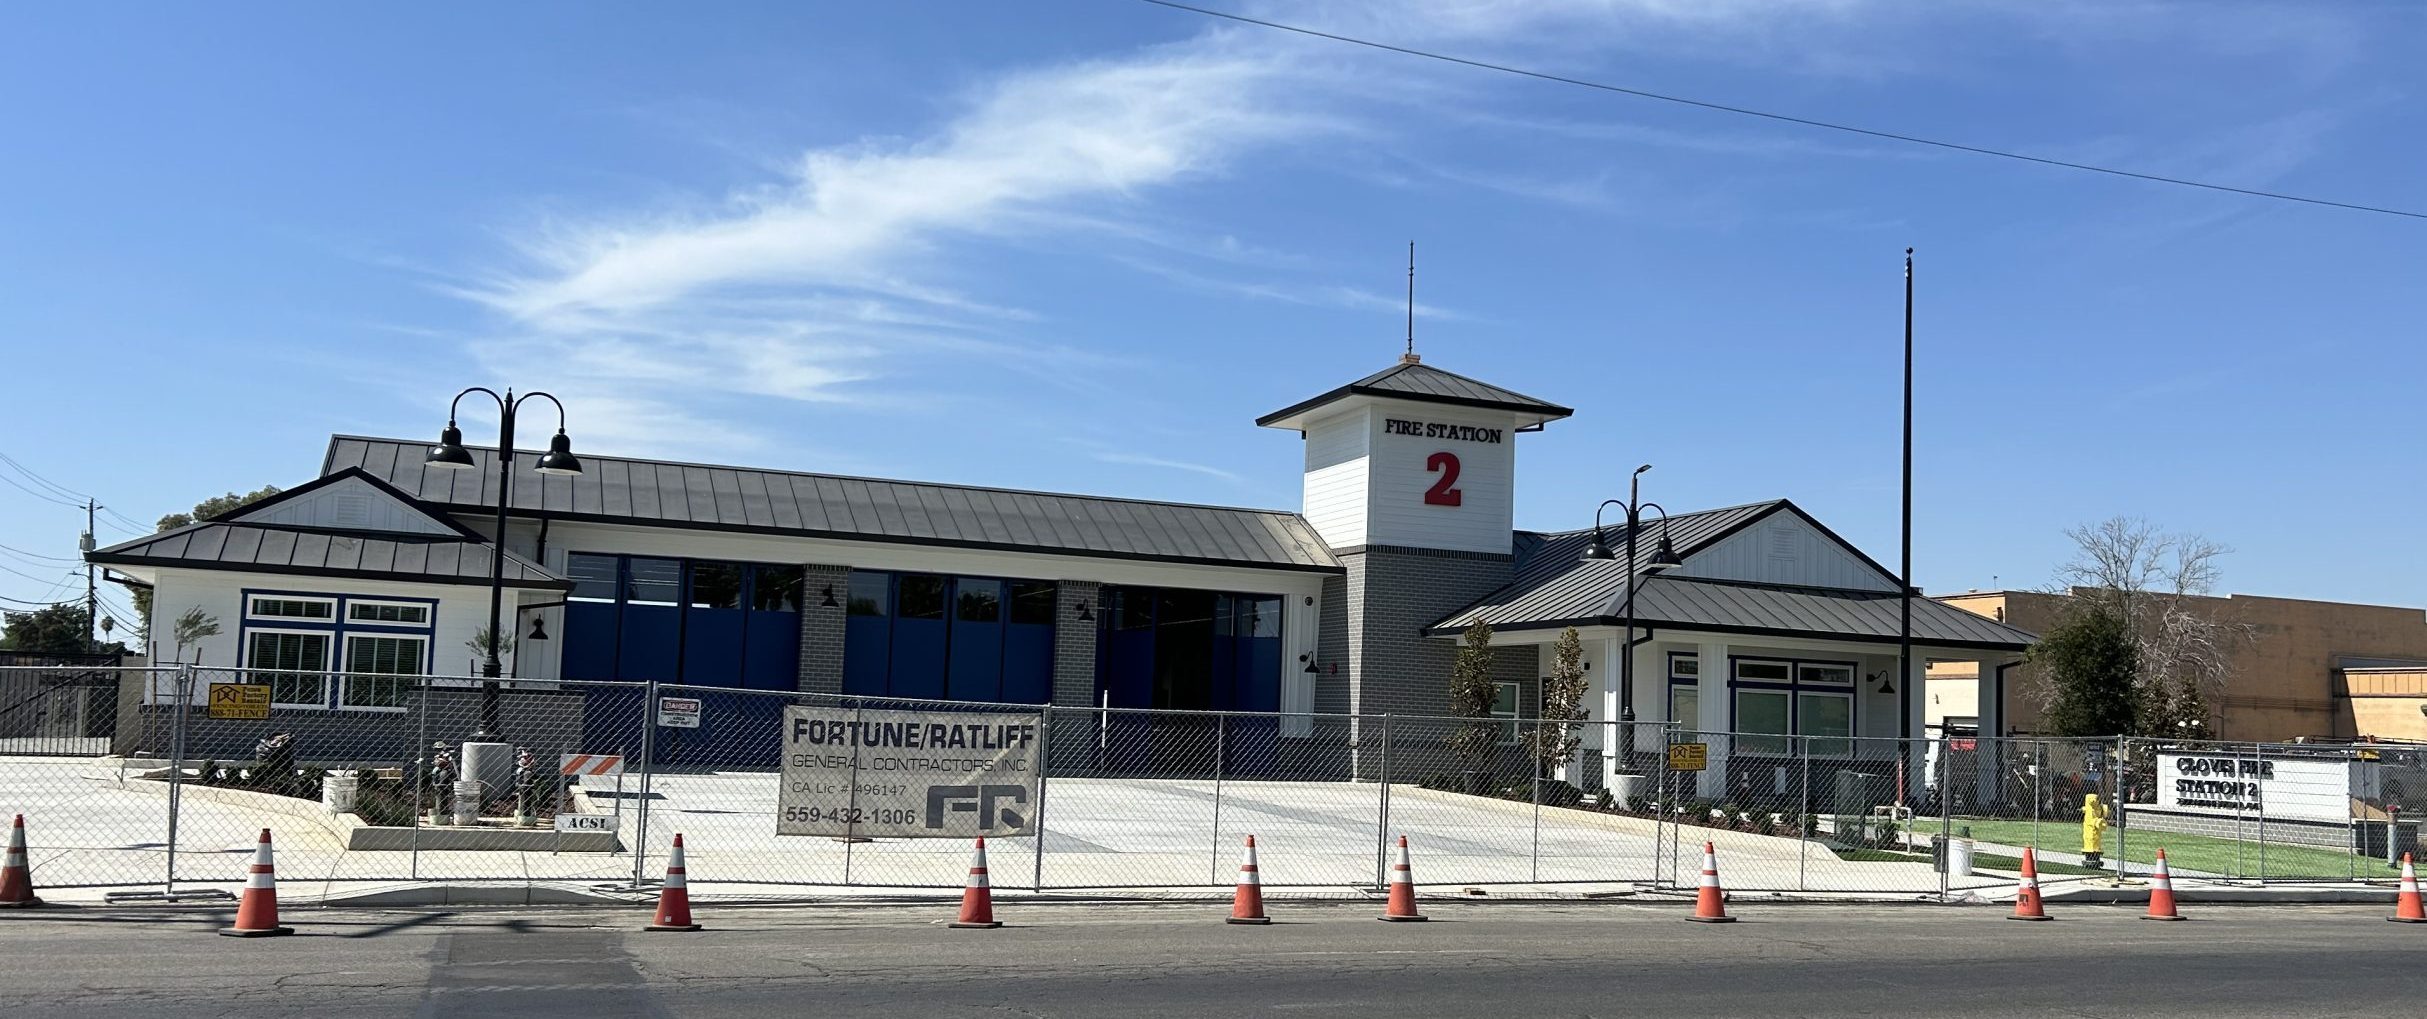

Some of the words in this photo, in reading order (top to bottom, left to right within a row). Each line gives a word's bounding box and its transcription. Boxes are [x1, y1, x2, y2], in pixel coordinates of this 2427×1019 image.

[1385, 418, 1423, 436] FIRE
[1426, 423, 1502, 443] STATION
[1424, 452, 1462, 507] 2
[664, 702, 698, 711] DANGER
[792, 718, 1034, 750] FORTUNE/RATLIFF
[792, 755, 867, 771] GENERAL
[873, 758, 997, 773] CONTRACTORS,
[1001, 759, 1029, 772] INC.
[792, 782, 811, 793] CA
[816, 783, 836, 794] Lic
[855, 784, 907, 796] 496147
[2176, 779, 2247, 796] STATION
[2248, 783, 2258, 797] 2
[786, 807, 916, 825] 559-432-1306
[926, 785, 1027, 830] FR
[568, 818, 606, 828] ACSI
